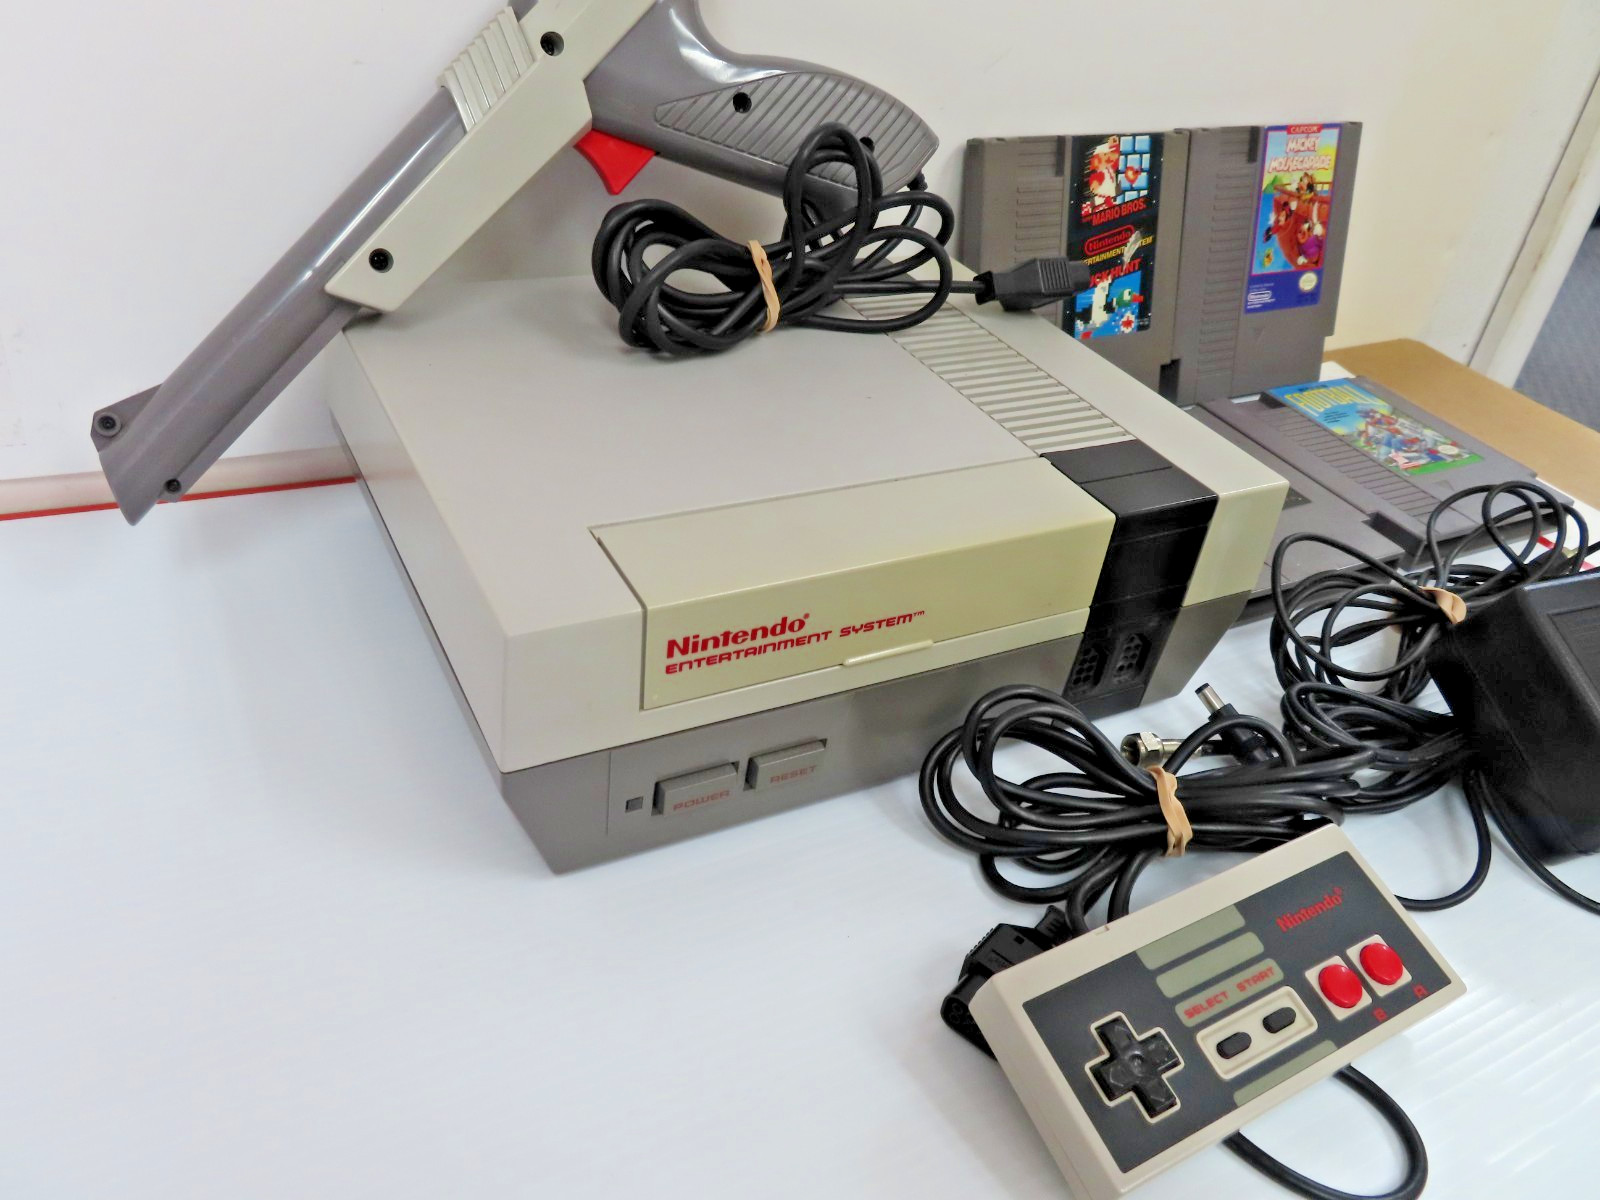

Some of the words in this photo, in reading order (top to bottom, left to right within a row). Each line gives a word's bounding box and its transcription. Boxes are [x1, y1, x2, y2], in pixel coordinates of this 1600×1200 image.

[1092, 206, 1120, 226] MARIO
[1089, 230, 1132, 251] Nintendo
[1111, 259, 1141, 278] HUNT
[665, 630, 833, 675] ENTERTAINMENT
[769, 765, 818, 785] RESET
[672, 789, 731, 811] POWER
[1183, 990, 1230, 1020] SELECT
[1236, 966, 1275, 993] START
[1413, 985, 1428, 998] A
[1373, 1008, 1388, 1022] B
